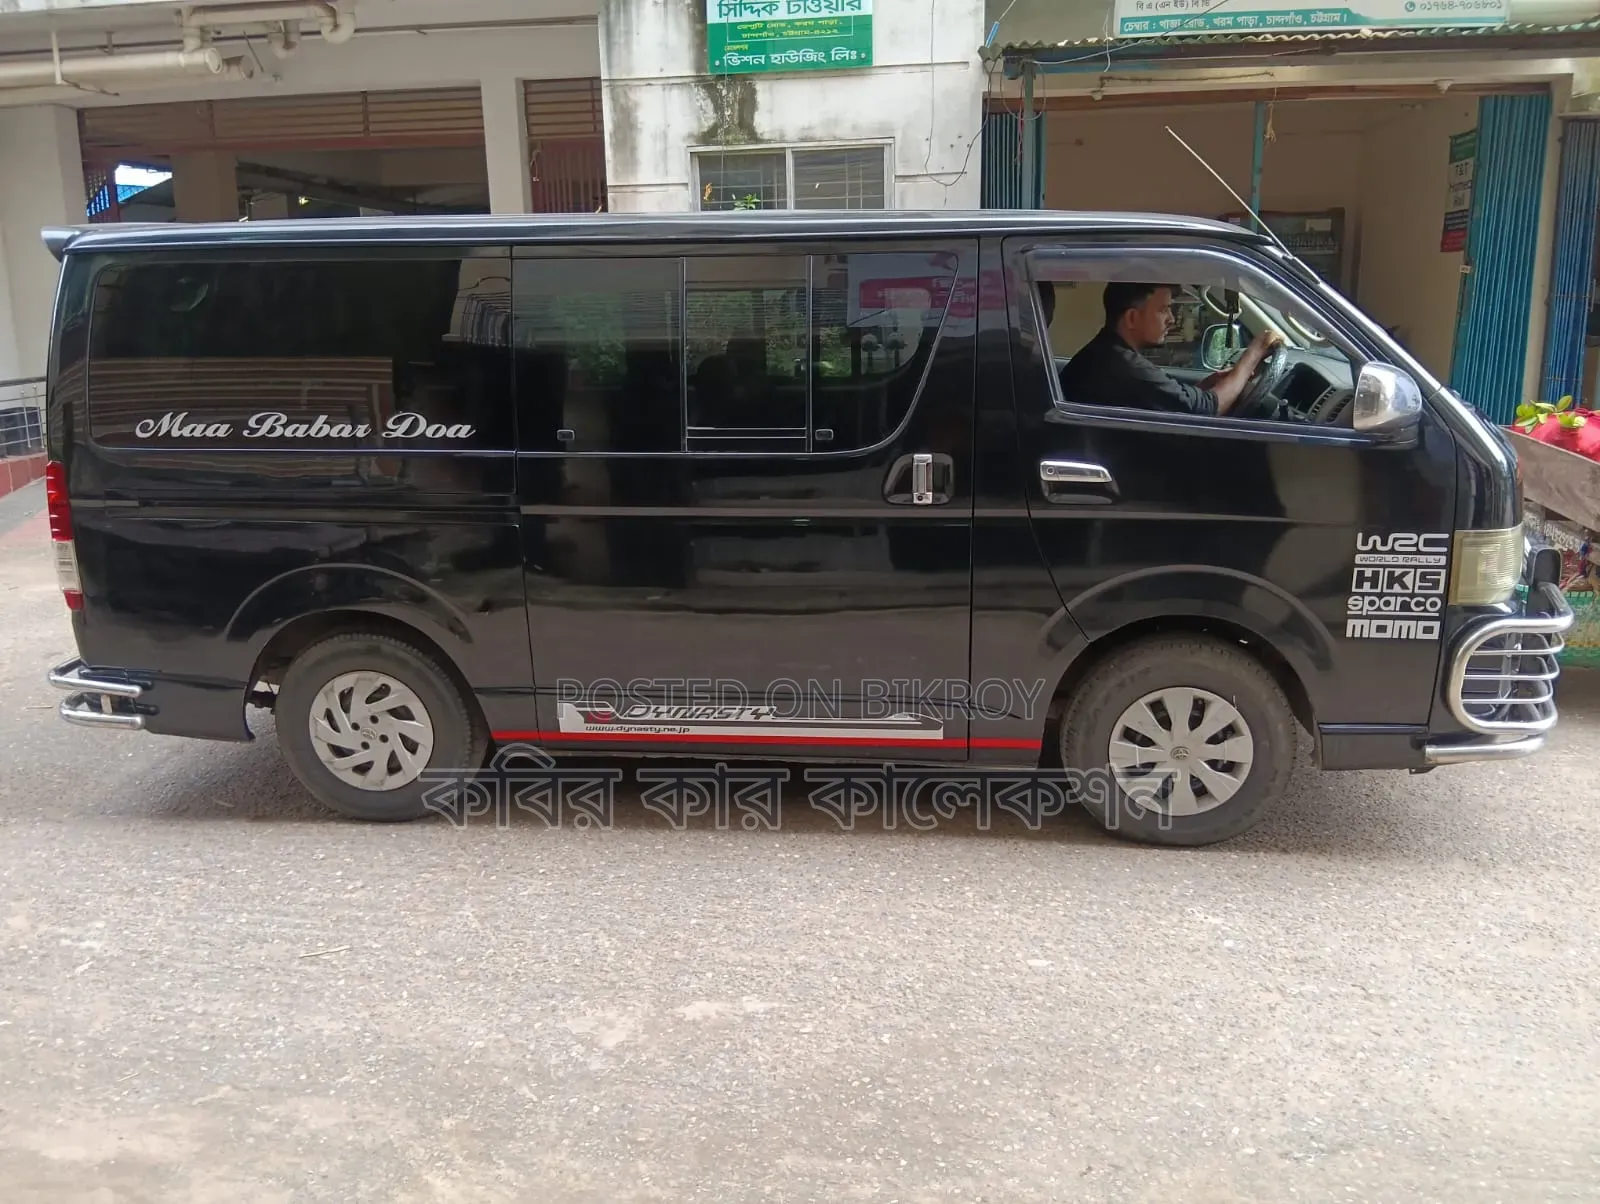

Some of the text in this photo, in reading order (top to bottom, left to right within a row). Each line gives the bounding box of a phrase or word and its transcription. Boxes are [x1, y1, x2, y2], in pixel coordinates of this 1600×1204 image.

[723, 46, 857, 67] ভিশন হাউজিং লিঃ
[135, 411, 476, 439] Maa Babar Doa
[1356, 532, 1449, 552] WRC
[1359, 555, 1441, 564] WORLD RALLY
[1353, 568, 1445, 593] HKS
[1347, 595, 1442, 616] sparco
[624, 705, 776, 720] DYNASTY
[585, 725, 690, 734] www.dynasty.ne.jp
